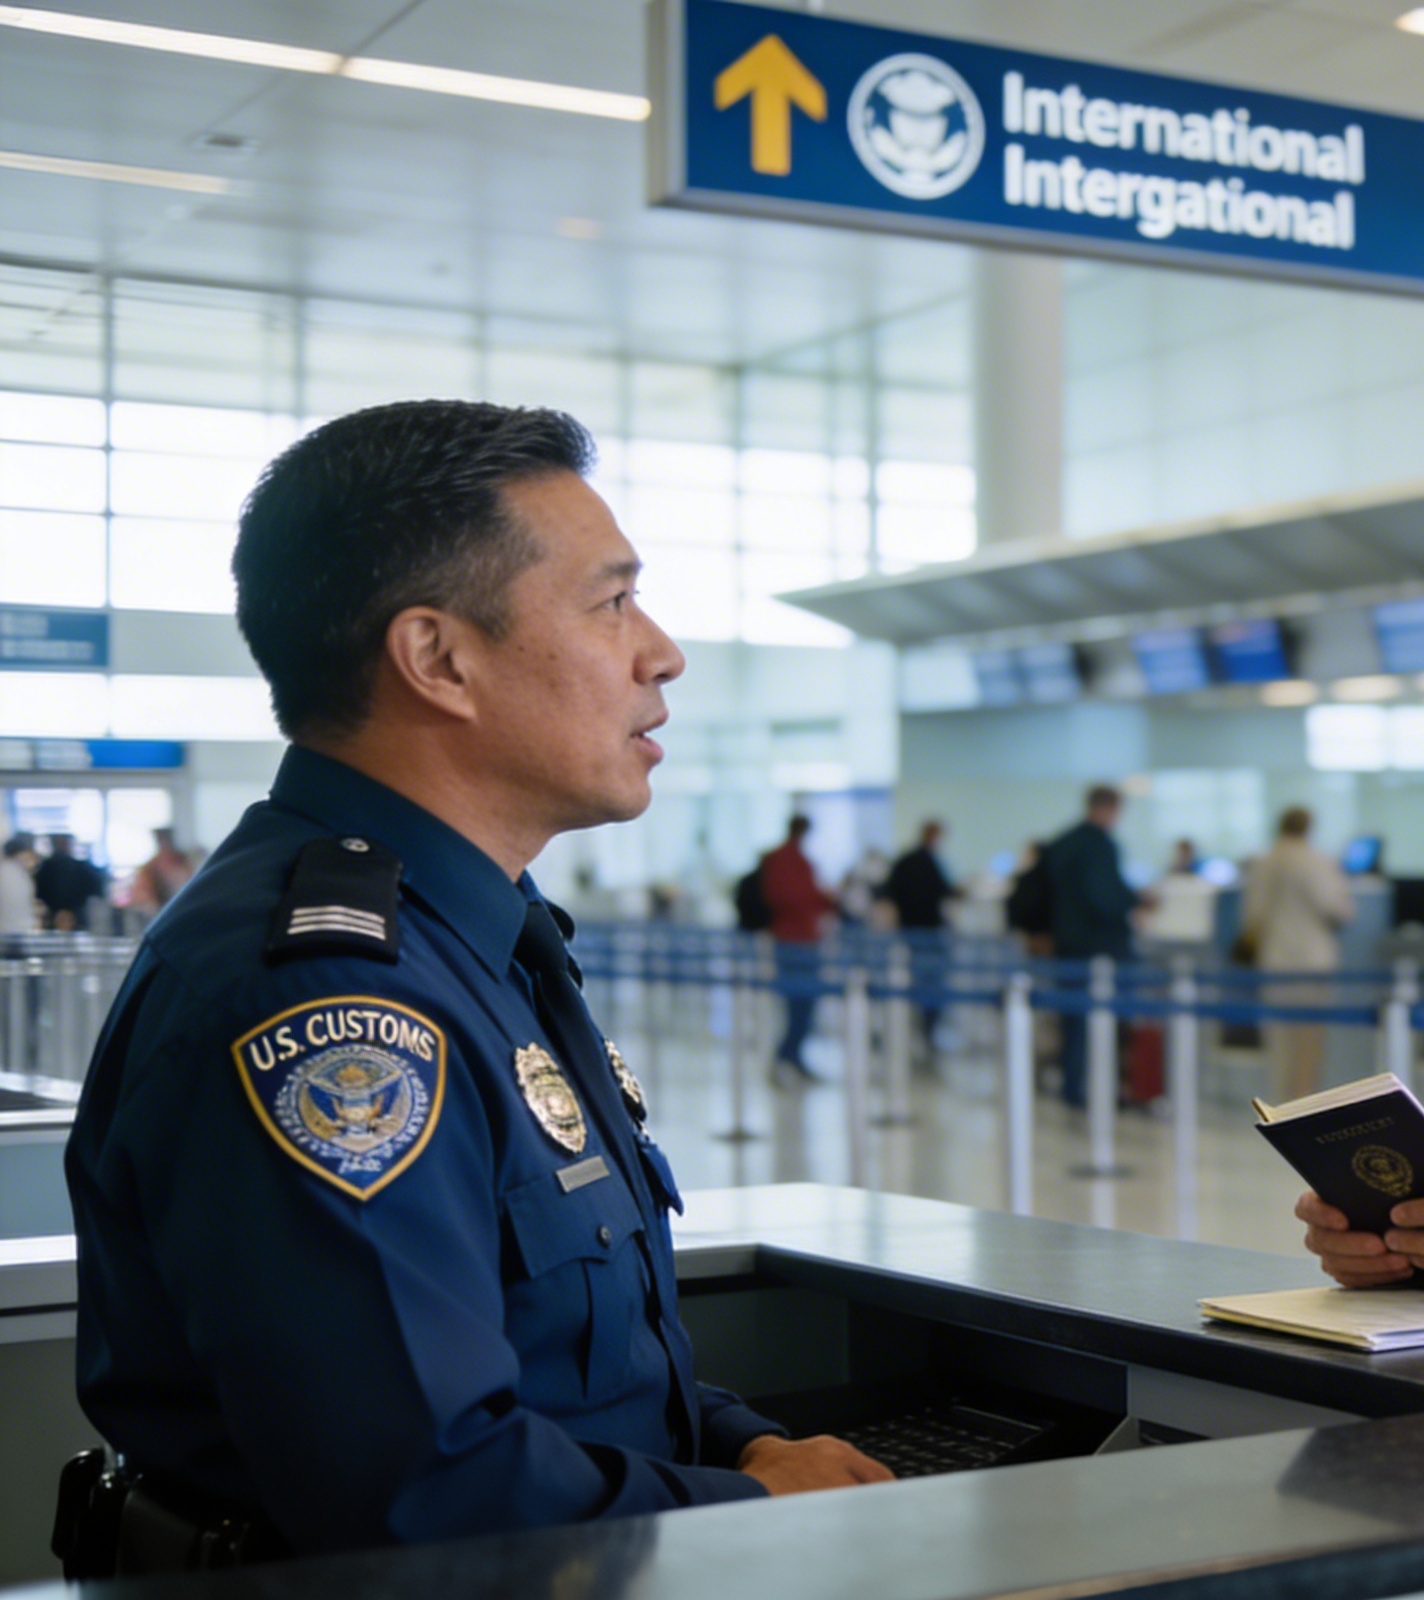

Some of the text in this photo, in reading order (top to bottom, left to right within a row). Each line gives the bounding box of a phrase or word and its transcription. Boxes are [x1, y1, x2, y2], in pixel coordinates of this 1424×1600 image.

[1003, 71, 1365, 185] International
[1004, 142, 1355, 250] Intergational
[250, 1009, 435, 1071] U.S. CUSTOMS
